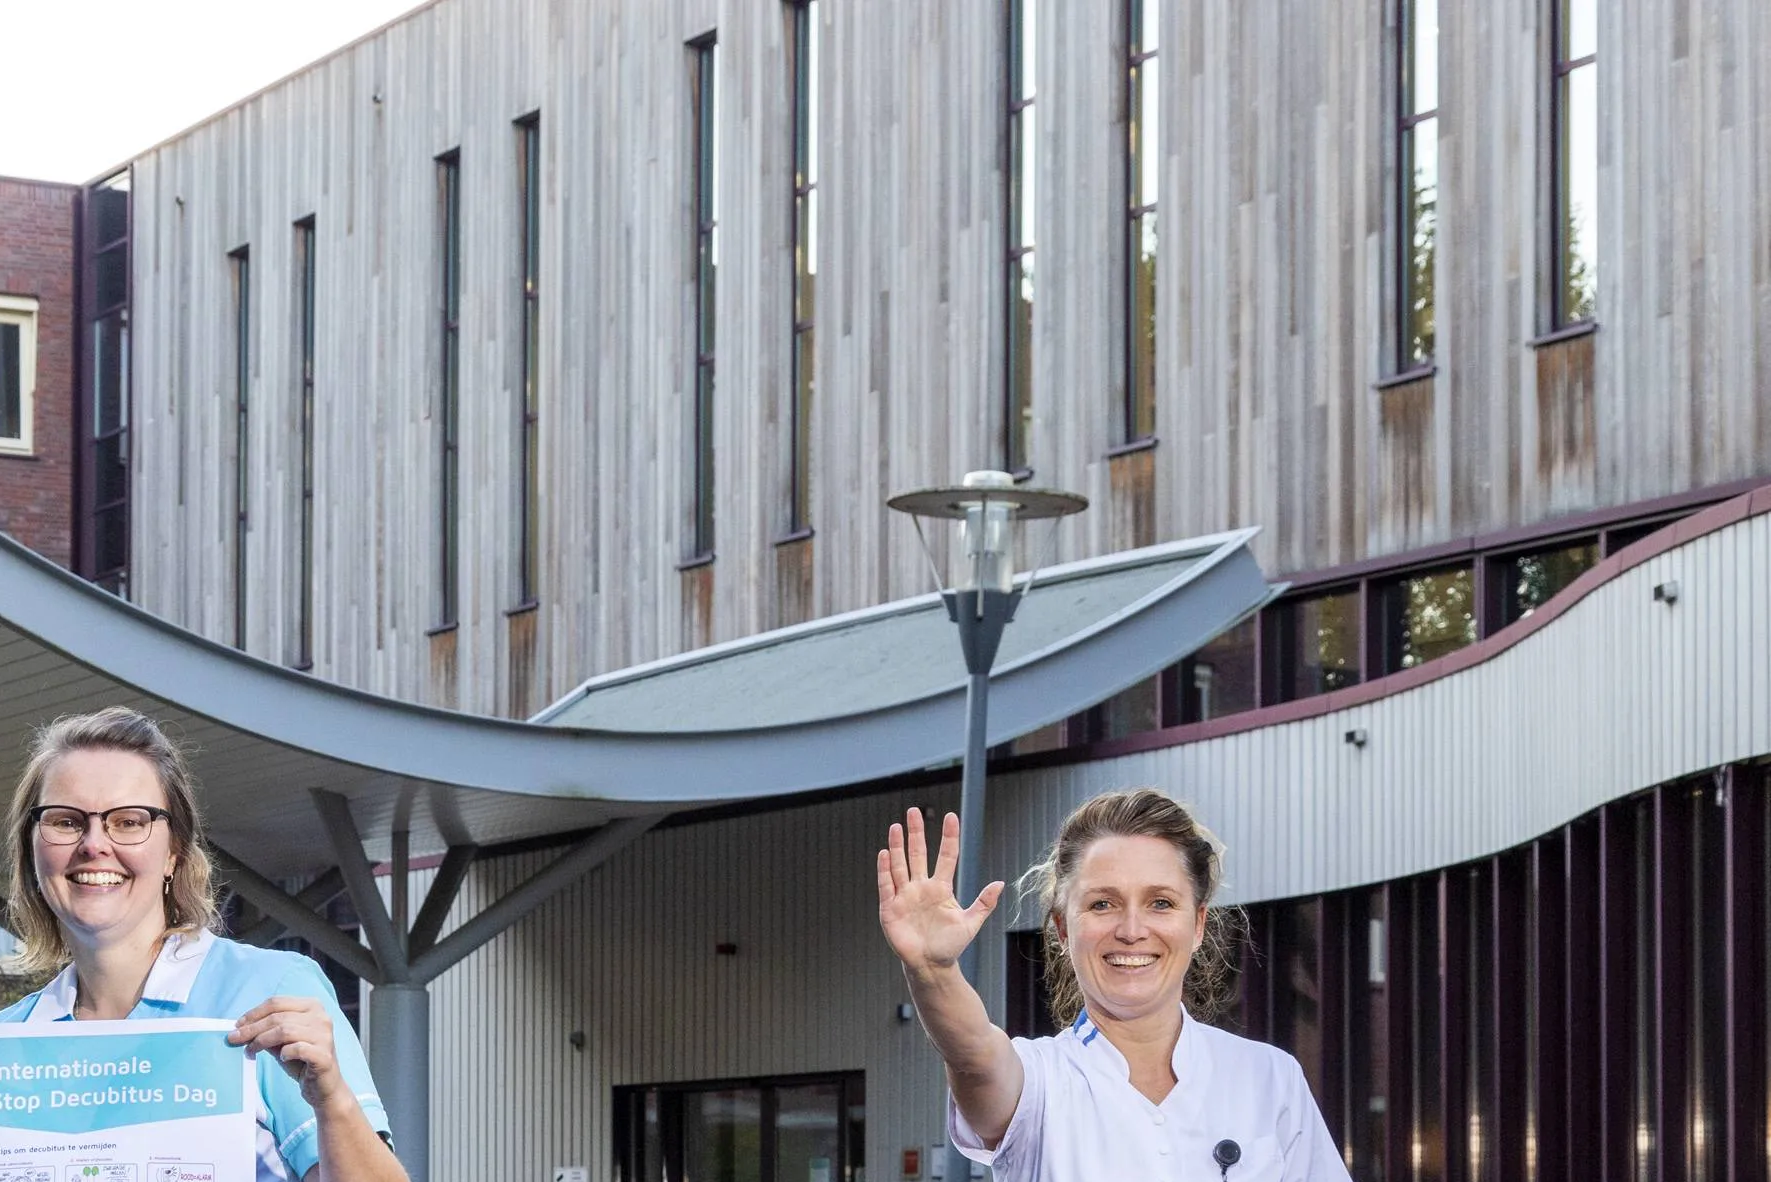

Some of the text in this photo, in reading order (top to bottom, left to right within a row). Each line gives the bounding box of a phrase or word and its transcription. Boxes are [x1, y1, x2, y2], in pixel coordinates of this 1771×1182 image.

[50, 1086, 164, 1108] Decubitus
[174, 1084, 218, 1107] Dag
[29, 1145, 66, 1153] decubitus
[78, 1142, 117, 1150] vermijden
